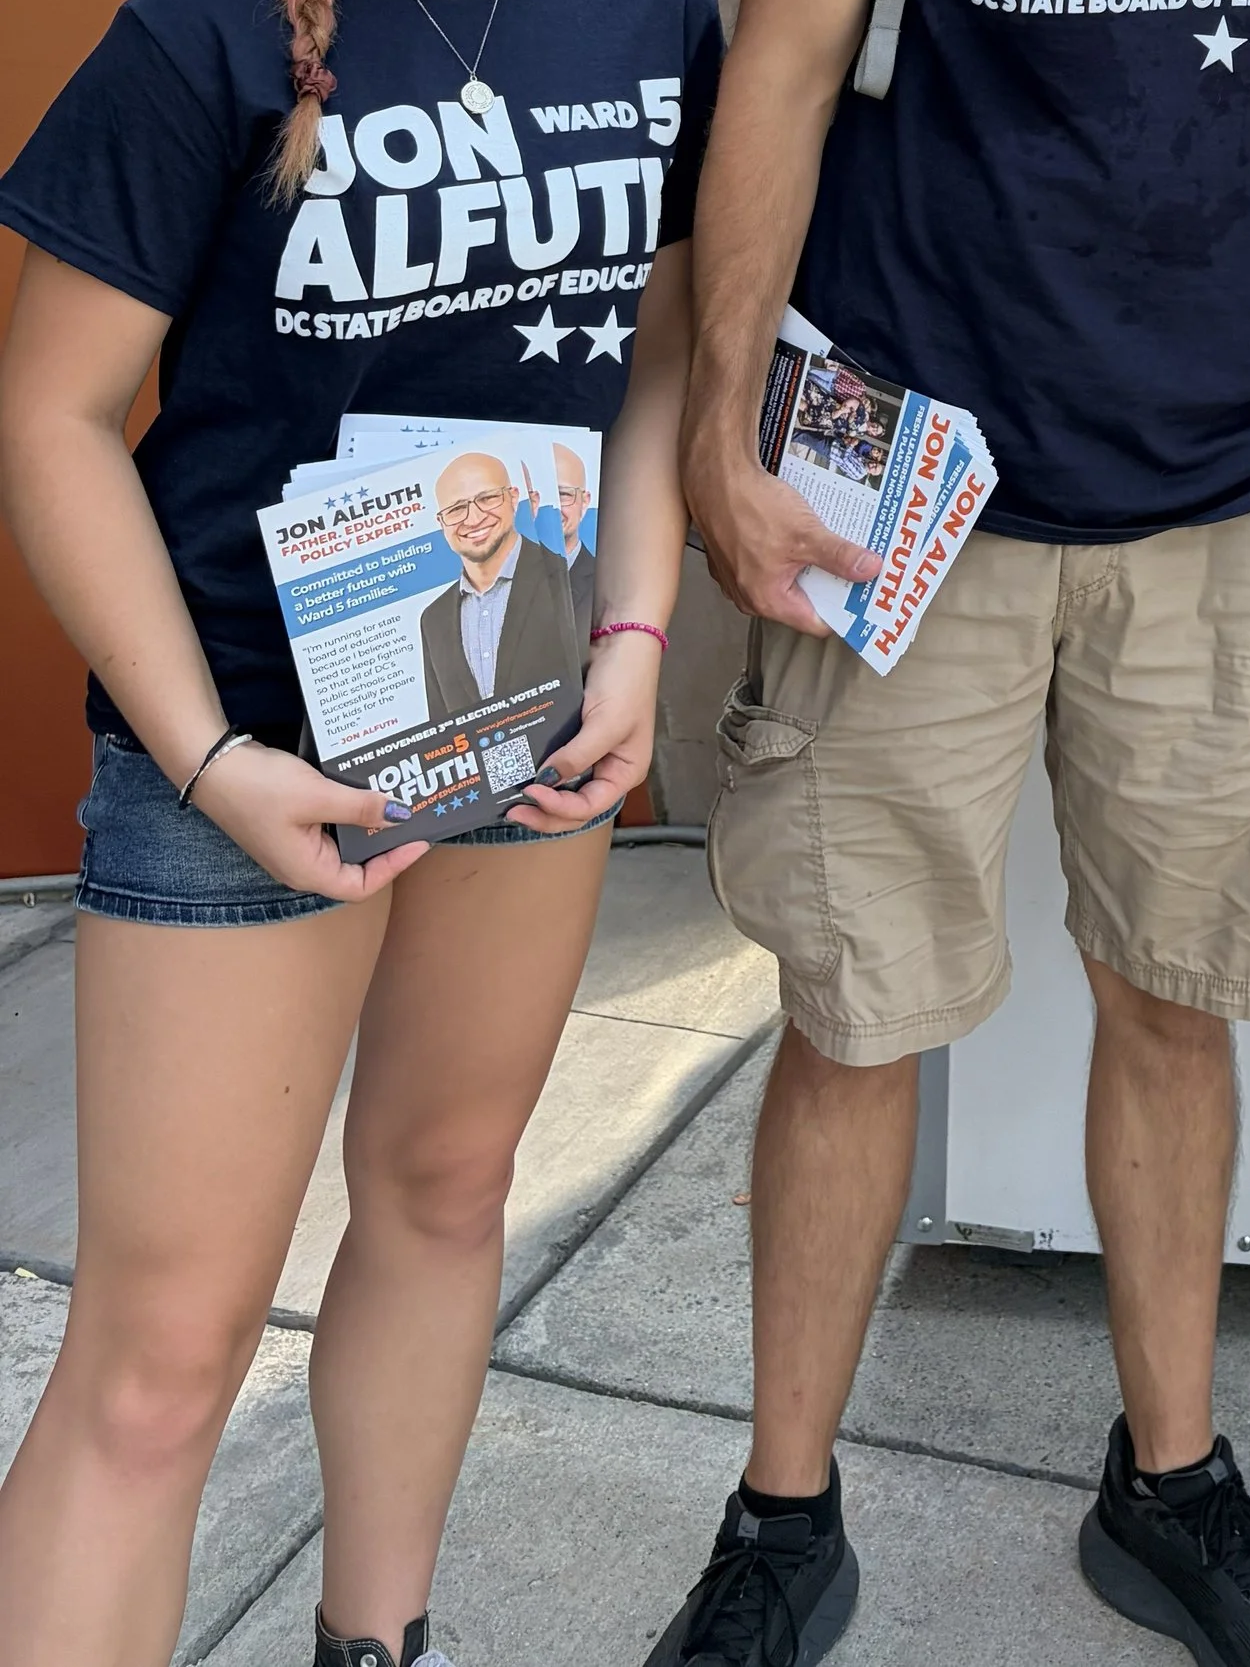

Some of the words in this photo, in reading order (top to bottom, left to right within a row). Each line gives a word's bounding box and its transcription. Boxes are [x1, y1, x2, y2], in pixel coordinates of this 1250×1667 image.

[303, 96, 524, 196] JON
[530, 101, 639, 133] WARD
[639, 77, 682, 146] 5
[275, 307, 312, 337] DC
[315, 305, 403, 340] STATE
[403, 282, 514, 323] BOARD
[517, 273, 559, 301] OF
[902, 426, 910, 435] A
[911, 404, 926, 436] FRESH
[895, 435, 909, 462] PLAN
[917, 412, 951, 481] JON
[883, 477, 897, 506] MOVE
[891, 464, 900, 477] TO
[275, 515, 326, 545] JON
[332, 483, 423, 526] ALFUTH
[878, 507, 888, 522] US
[881, 499, 899, 541] PROVEN
[942, 472, 986, 538] JON
[281, 531, 342, 557] FATHER.
[344, 502, 426, 535] EDUCATOR.
[300, 538, 352, 564] POLICY
[355, 518, 414, 545] EXPERT.
[874, 484, 928, 613] ALFUTH
[290, 563, 364, 597] Committed
[365, 561, 380, 571] to
[380, 541, 433, 567] building
[294, 602, 303, 612] a
[304, 587, 345, 608] better
[346, 573, 386, 593] future
[387, 561, 417, 578] with
[297, 604, 334, 625] Ward
[335, 601, 345, 613] 5
[345, 584, 399, 608] families.
[337, 759, 352, 772] IN
[351, 750, 376, 766] THE
[375, 726, 438, 757] NOVEMBER
[454, 699, 510, 726] ELECTION,
[509, 687, 539, 705] VOTE
[538, 679, 561, 694] FOR
[341, 732, 361, 745] JON
[362, 717, 399, 736] ALFUTH
[423, 744, 454, 761] WARD
[453, 733, 470, 753] 5
